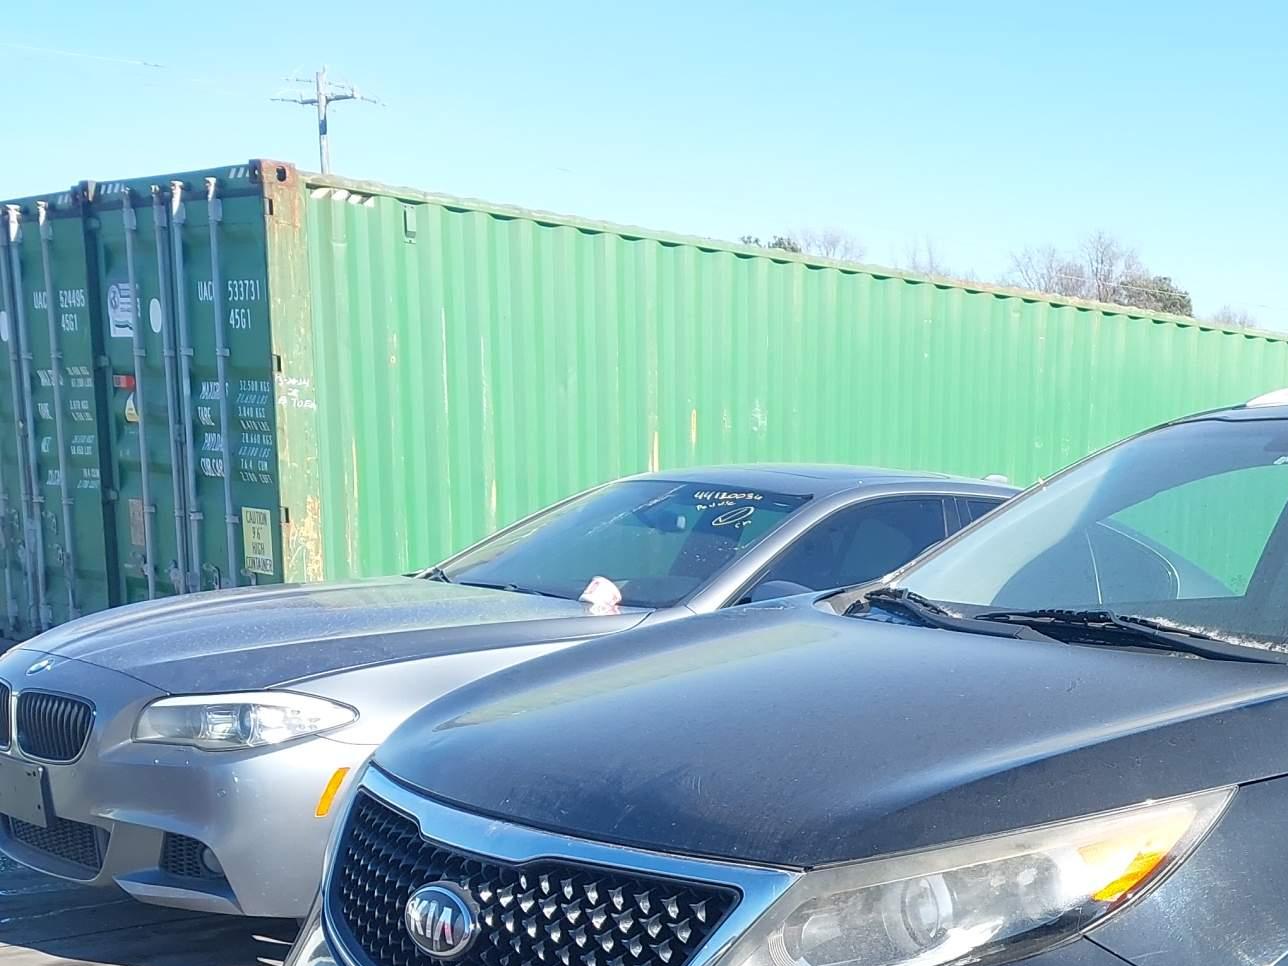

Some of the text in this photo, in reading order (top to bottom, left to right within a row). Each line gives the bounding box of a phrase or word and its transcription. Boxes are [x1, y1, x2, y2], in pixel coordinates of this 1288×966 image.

[59, 289, 85, 308] 524495
[197, 279, 260, 301] UAC 533731
[61, 313, 79, 331] 45G1
[229, 308, 251, 329] 45G1
[245, 511, 267, 525] CAUTION
[245, 556, 272, 572] CONTAINER
